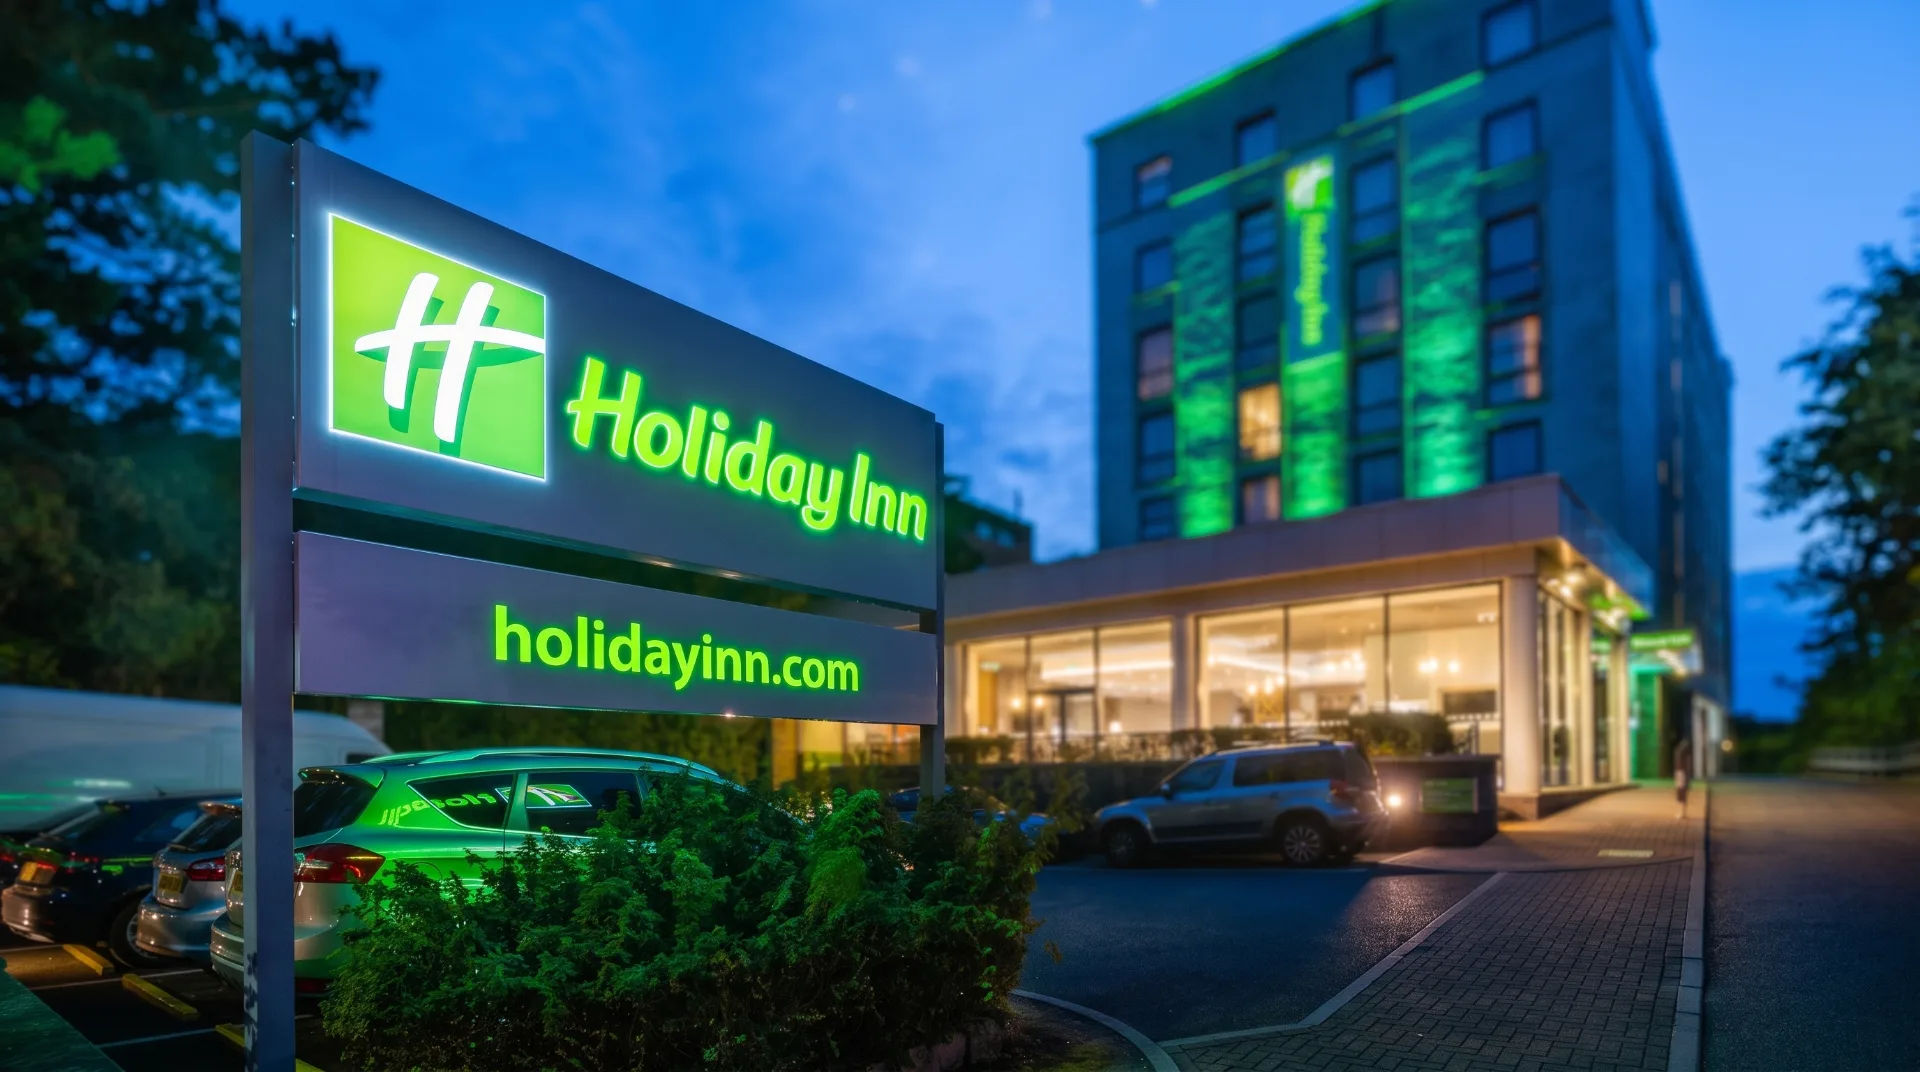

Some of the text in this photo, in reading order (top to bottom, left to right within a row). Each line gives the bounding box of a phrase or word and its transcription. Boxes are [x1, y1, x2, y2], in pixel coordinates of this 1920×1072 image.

[567, 356, 928, 541] Holiday Inn
[494, 604, 860, 691] holidayinn.com
